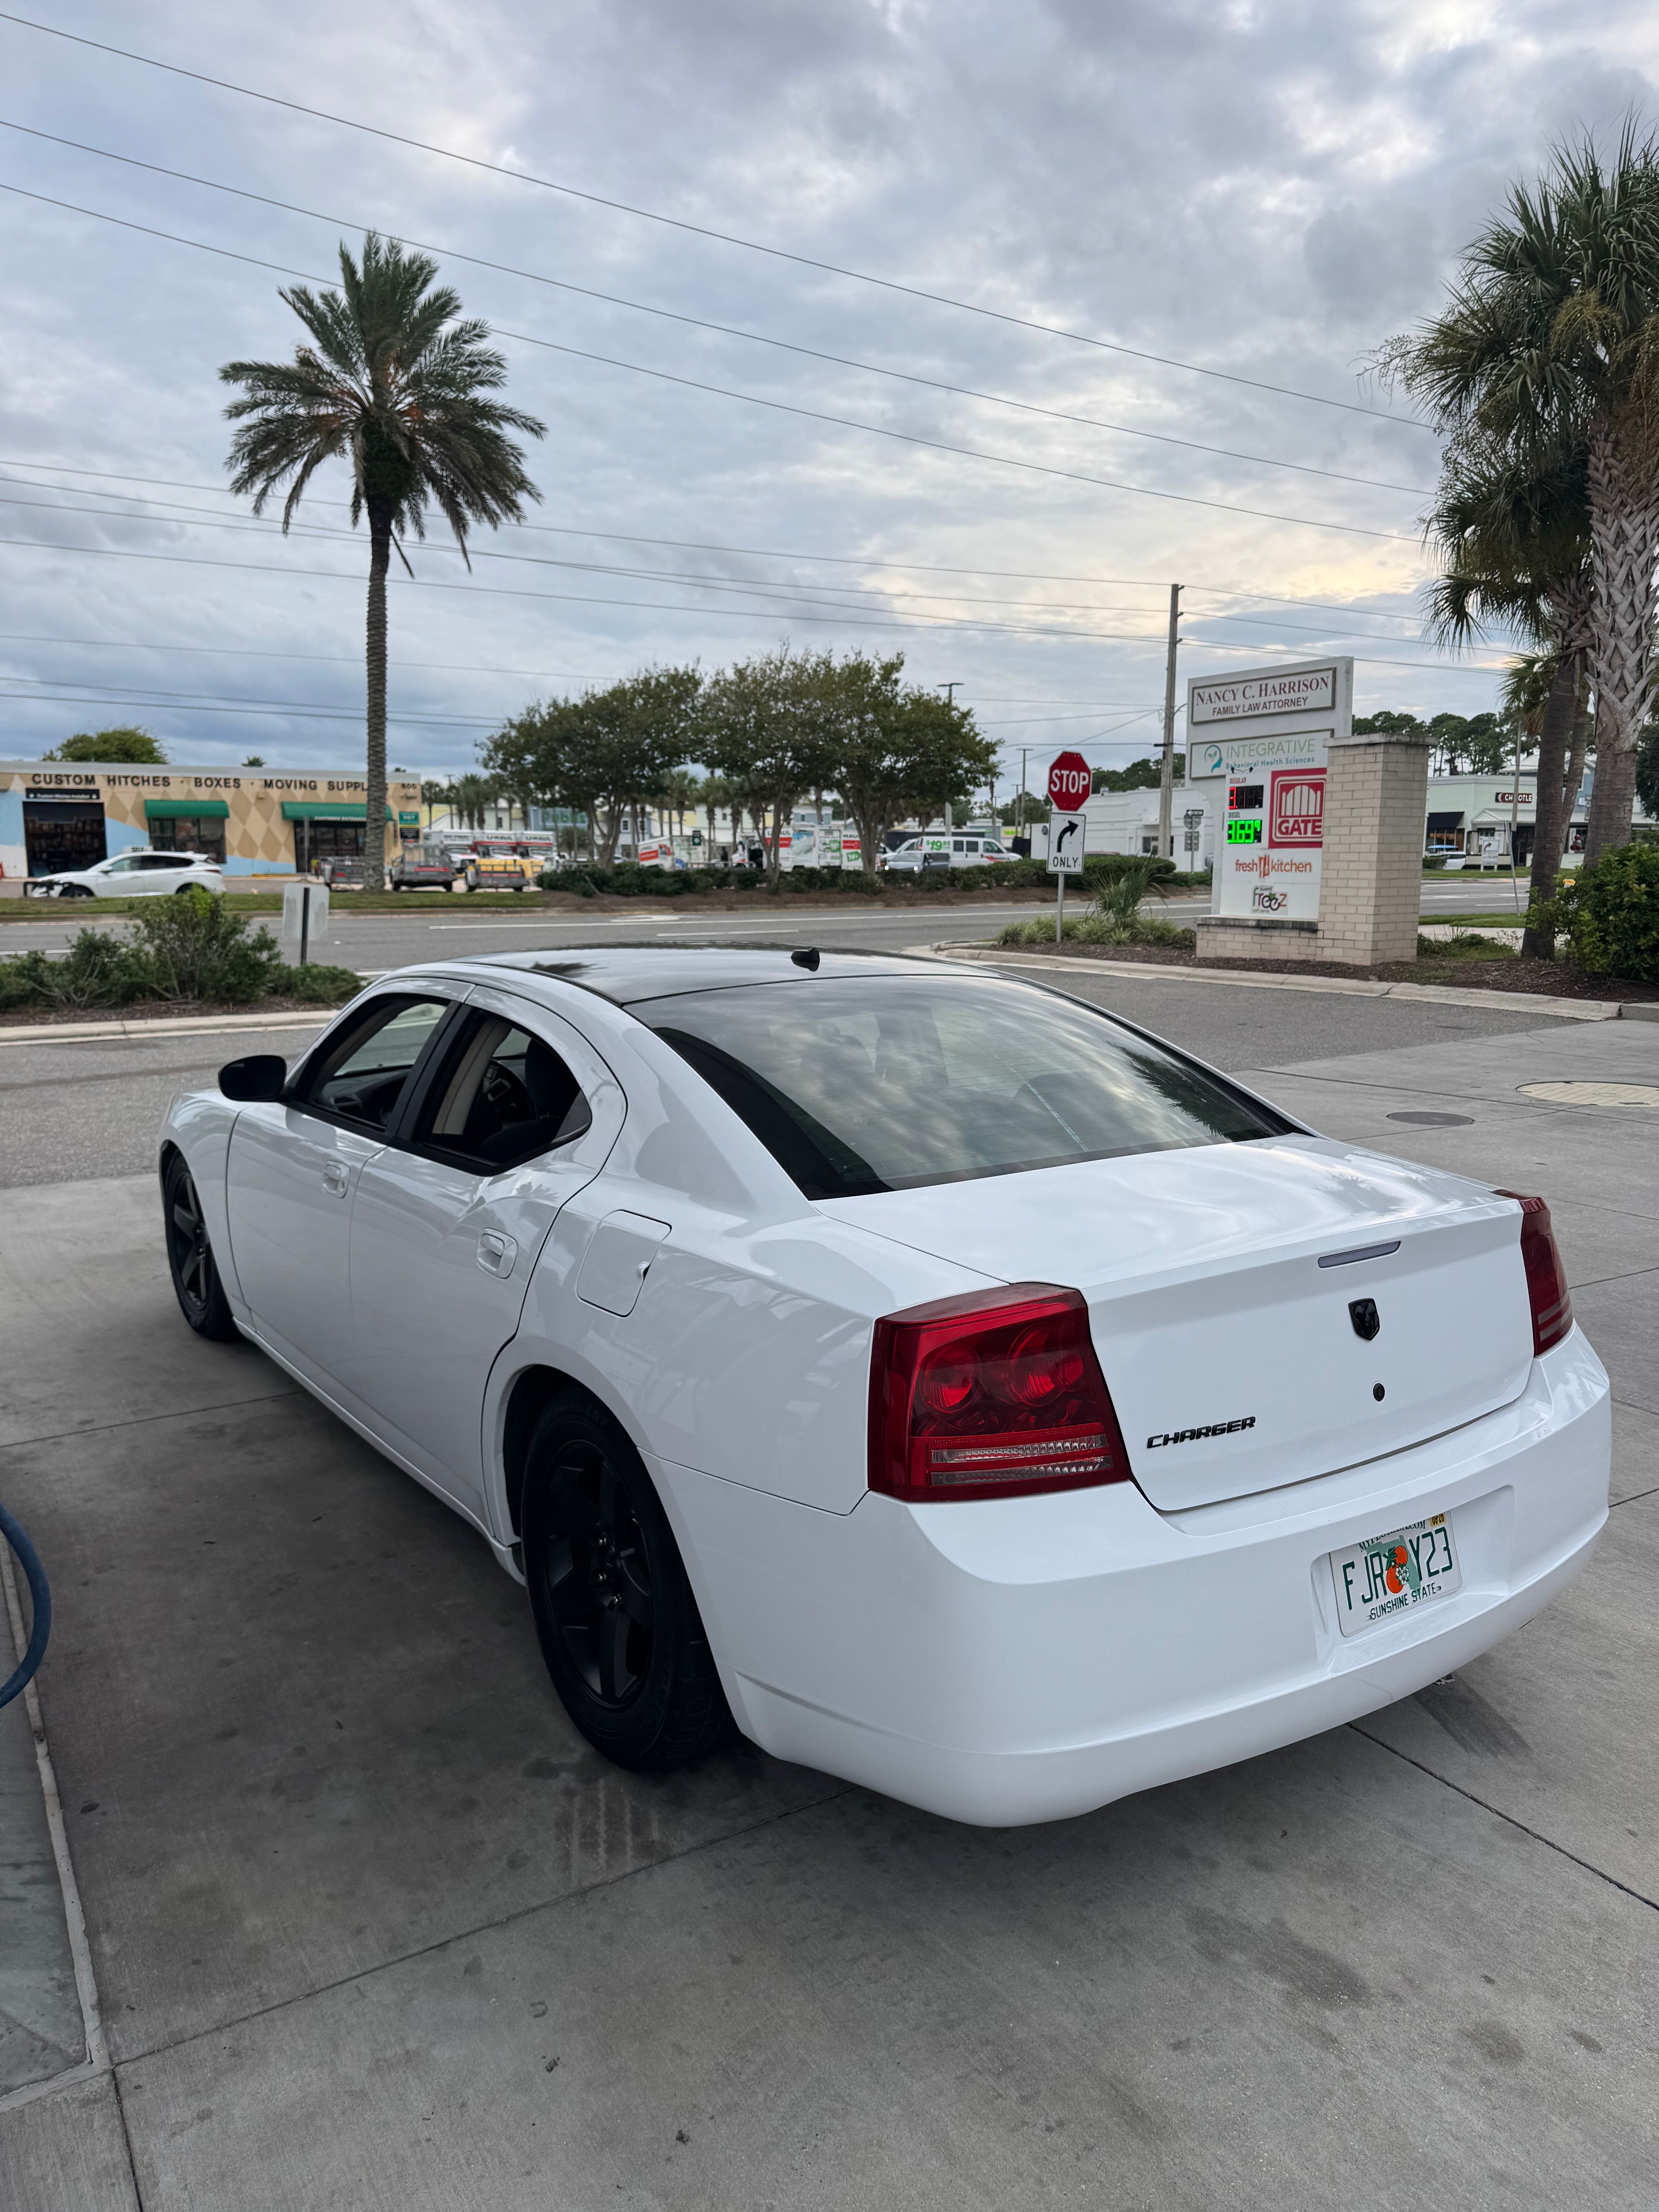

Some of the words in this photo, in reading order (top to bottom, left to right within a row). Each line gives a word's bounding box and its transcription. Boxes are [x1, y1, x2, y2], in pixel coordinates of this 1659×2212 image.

[1196, 688, 1239, 706] NANCY
[1242, 685, 1255, 699] C.
[1259, 676, 1329, 697] HARRISON
[1212, 705, 1240, 716] FAMILY
[1242, 702, 1260, 713] LAW
[1261, 696, 1309, 711] ATTORNEY
[1226, 738, 1316, 759] INTEGRATIVE
[1285, 756, 1315, 764] Sciences
[32, 774, 95, 785] CUSTOM
[107, 775, 171, 787] HITCHES
[194, 777, 241, 788] BOXES
[264, 779, 318, 791] MOVING
[1050, 769, 1089, 794] STOP
[1278, 819, 1322, 836] GATE
[1053, 857, 1079, 868] ONLY
[1235, 859, 1258, 872] fresh
[1271, 859, 1312, 872] kitchen
[1147, 1416, 1256, 1448] CHARGER
[1370, 1593, 1409, 1620] SUNSHINE
[1411, 1582, 1437, 1602] STATE
